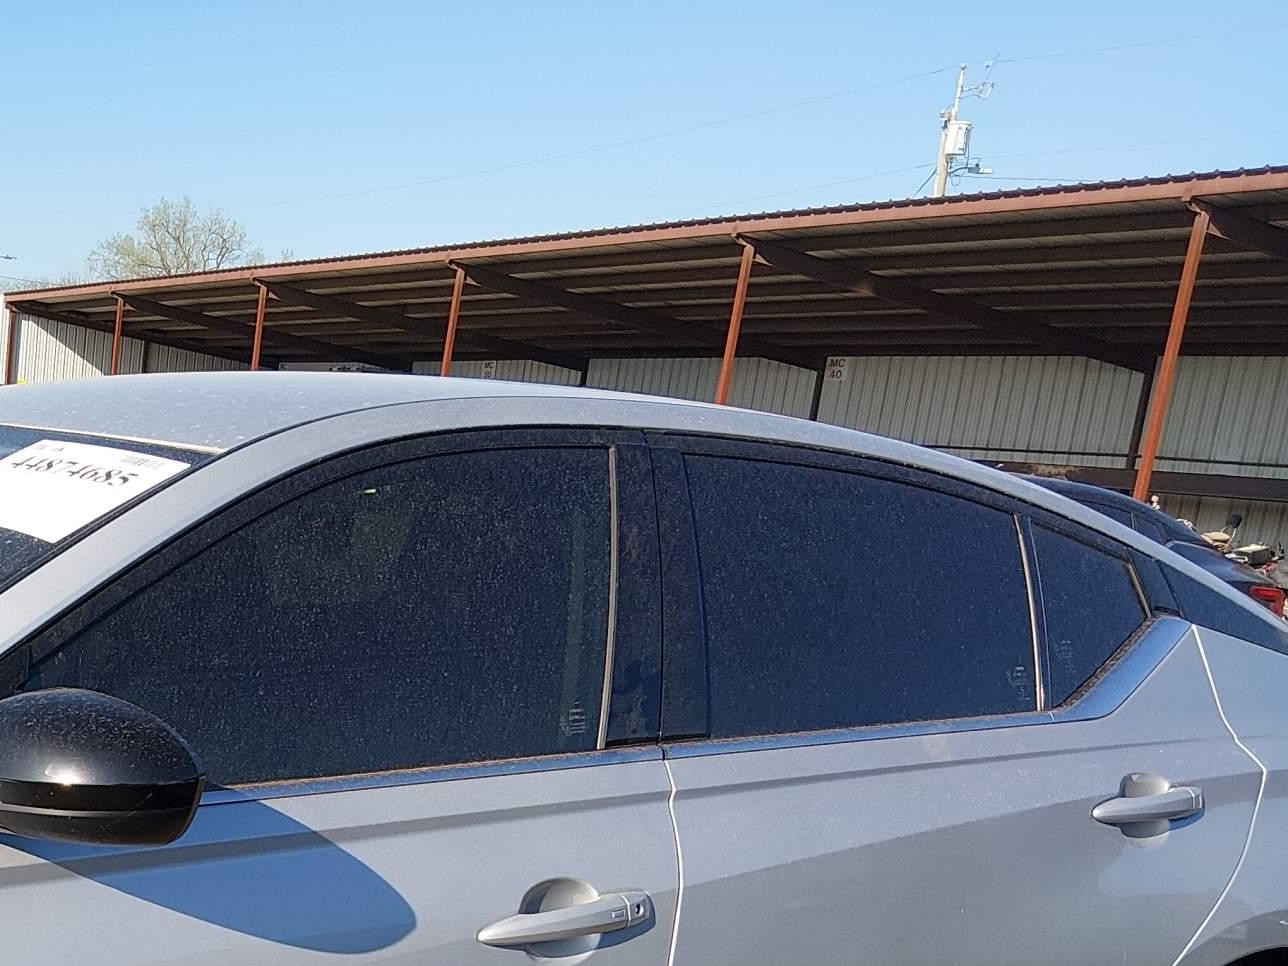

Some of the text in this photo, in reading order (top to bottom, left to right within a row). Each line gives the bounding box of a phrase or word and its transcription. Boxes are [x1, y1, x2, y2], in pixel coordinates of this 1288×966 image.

[829, 358, 846, 367] MC
[829, 370, 843, 379] 40
[11, 456, 140, 486] 44874685
